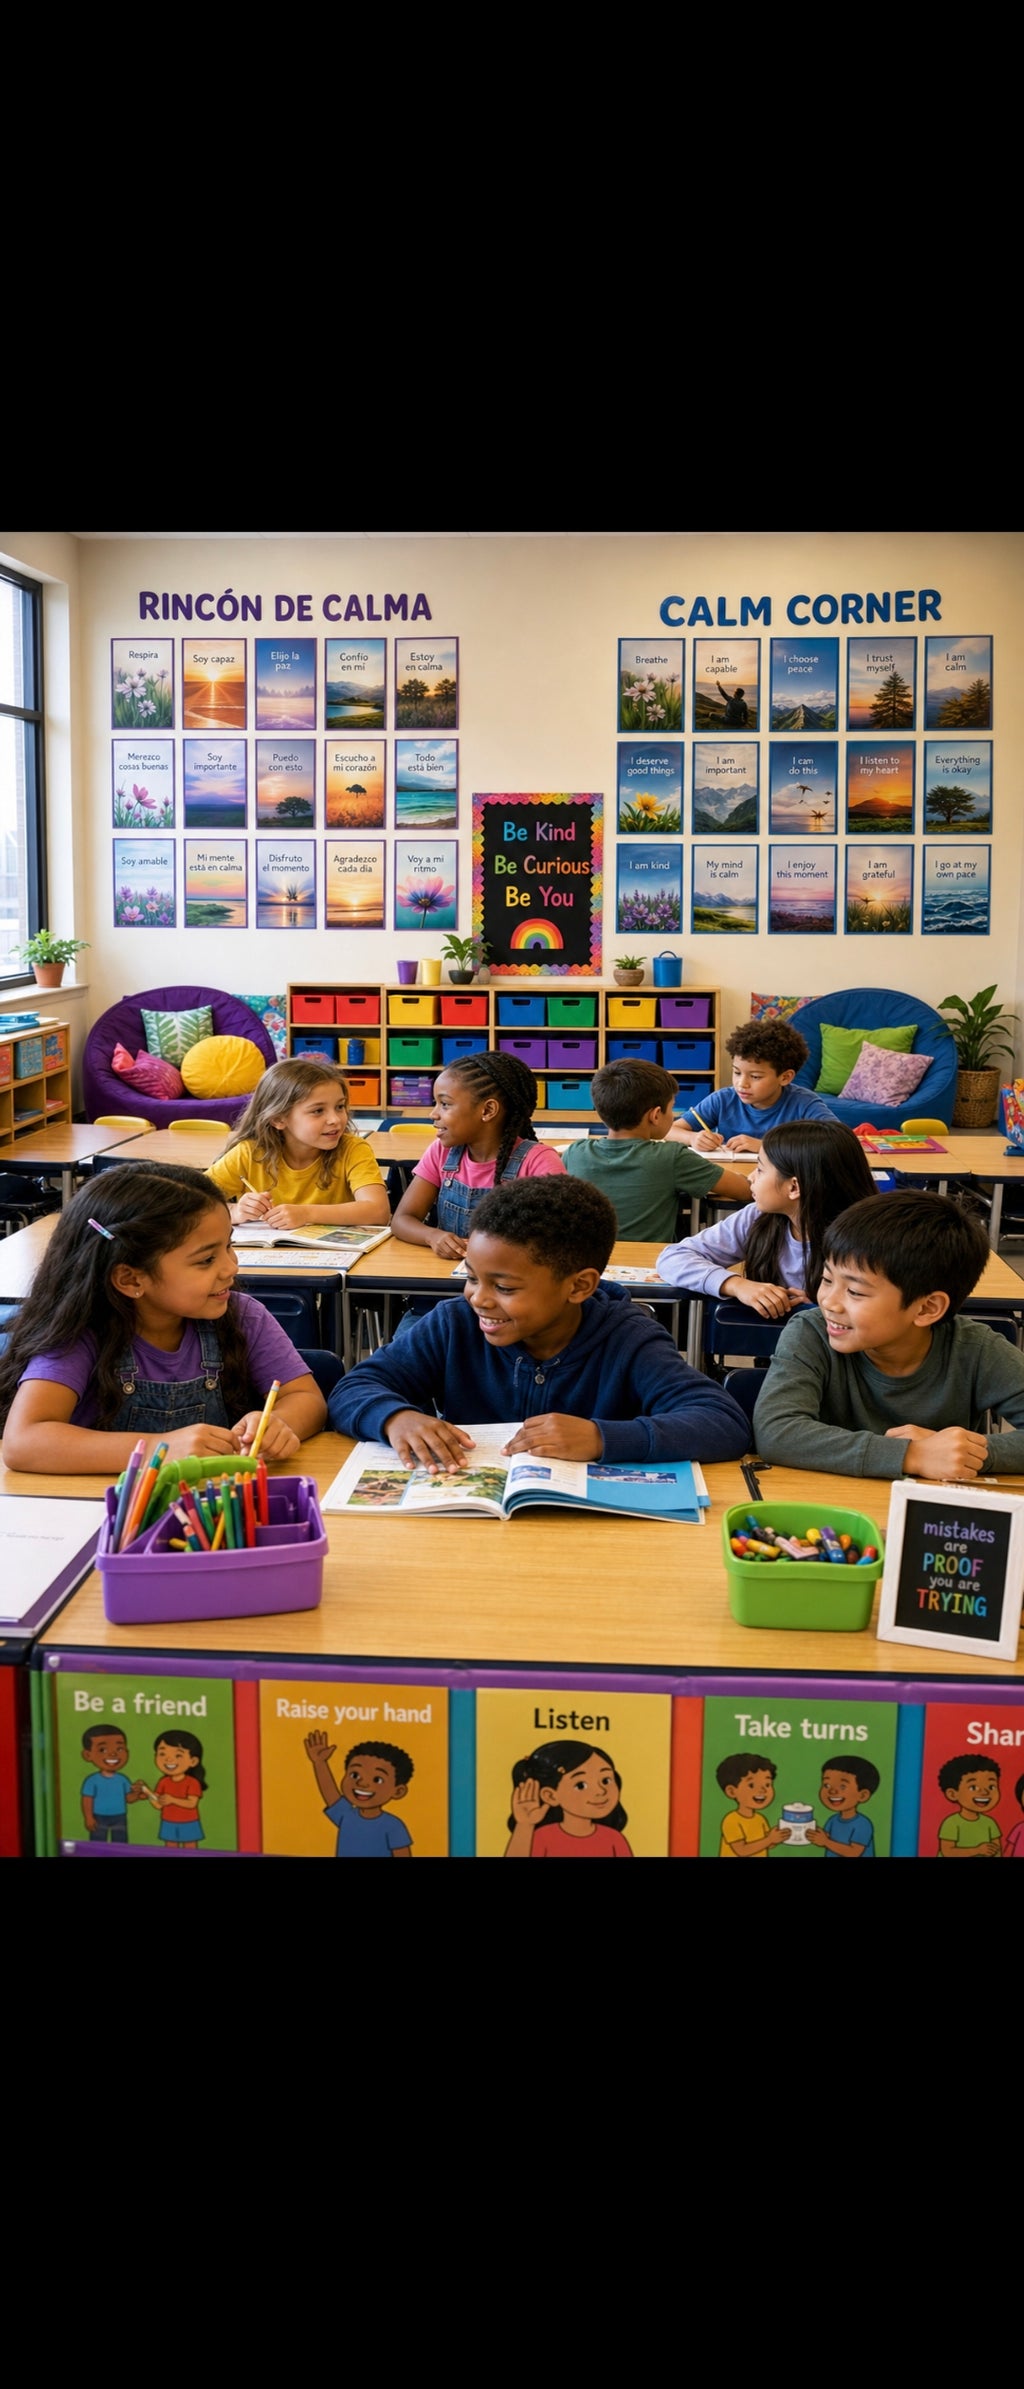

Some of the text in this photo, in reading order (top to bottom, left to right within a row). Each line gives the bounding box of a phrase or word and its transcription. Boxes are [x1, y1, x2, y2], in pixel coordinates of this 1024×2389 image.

[139, 588, 432, 622] RINCÓN DE CALMA
[660, 589, 942, 627] CALM CORNER
[128, 651, 158, 660] Respira
[193, 654, 235, 664] Soy capaz
[270, 652, 300, 662] Elijo la
[410, 652, 435, 664] Estoy
[635, 655, 668, 664] Breathe
[789, 654, 819, 663] choose
[872, 654, 893, 662] trust
[275, 663, 291, 672] paz
[341, 663, 352, 671] en
[418, 662, 443, 671] calma
[705, 665, 737, 674] capable
[788, 666, 813, 675] peace
[866, 663, 895, 674] myself
[945, 663, 966, 671] calm
[127, 753, 160, 761] Merezco
[207, 753, 222, 762] Soy
[273, 754, 299, 762] Puedo
[335, 754, 368, 762] Escucho
[415, 754, 436, 762] Todo
[636, 757, 669, 765] deserve
[864, 756, 888, 765] listen
[890, 757, 900, 765] to
[935, 755, 980, 765] Everything
[141, 763, 168, 771] buenas
[194, 763, 237, 772] importante
[268, 764, 303, 772] con esto
[333, 763, 343, 772] mi
[426, 763, 444, 772] bien
[627, 767, 675, 776] good things
[705, 766, 747, 775] important
[789, 766, 818, 775] do this
[860, 766, 899, 776] my heart
[942, 765, 972, 775] is okay
[503, 821, 576, 841] Be Kind
[121, 856, 168, 866] Soy amable
[197, 854, 235, 862] Mi mente
[268, 854, 302, 863] Disfruto
[333, 855, 377, 865] Agradezco
[408, 855, 423, 865] Voy
[219, 864, 243, 872] calma
[262, 864, 270, 872] el
[338, 864, 358, 873] cada
[413, 864, 437, 873] ritmo
[494, 855, 590, 875] Be Curious
[635, 862, 648, 870] am
[651, 861, 670, 870] kind
[706, 860, 743, 870] My mind
[792, 861, 816, 871] enjoy
[940, 862, 951, 870] go
[953, 861, 962, 869] at
[964, 862, 977, 870] my
[710, 870, 739, 878] is calm
[862, 870, 895, 880] grateful
[956, 872, 976, 880] pace
[505, 886, 574, 907] Be You
[923, 1521, 995, 1544] mistakes
[944, 1542, 968, 1554] are
[923, 1552, 984, 1578] PROOF
[929, 1576, 981, 1591] you are
[917, 1588, 987, 1617] TRYING
[73, 1691, 207, 1717] Be a friend
[276, 1698, 432, 1725] Raise your hand
[533, 1707, 611, 1732] Listen
[734, 1713, 868, 1742] Take turns
